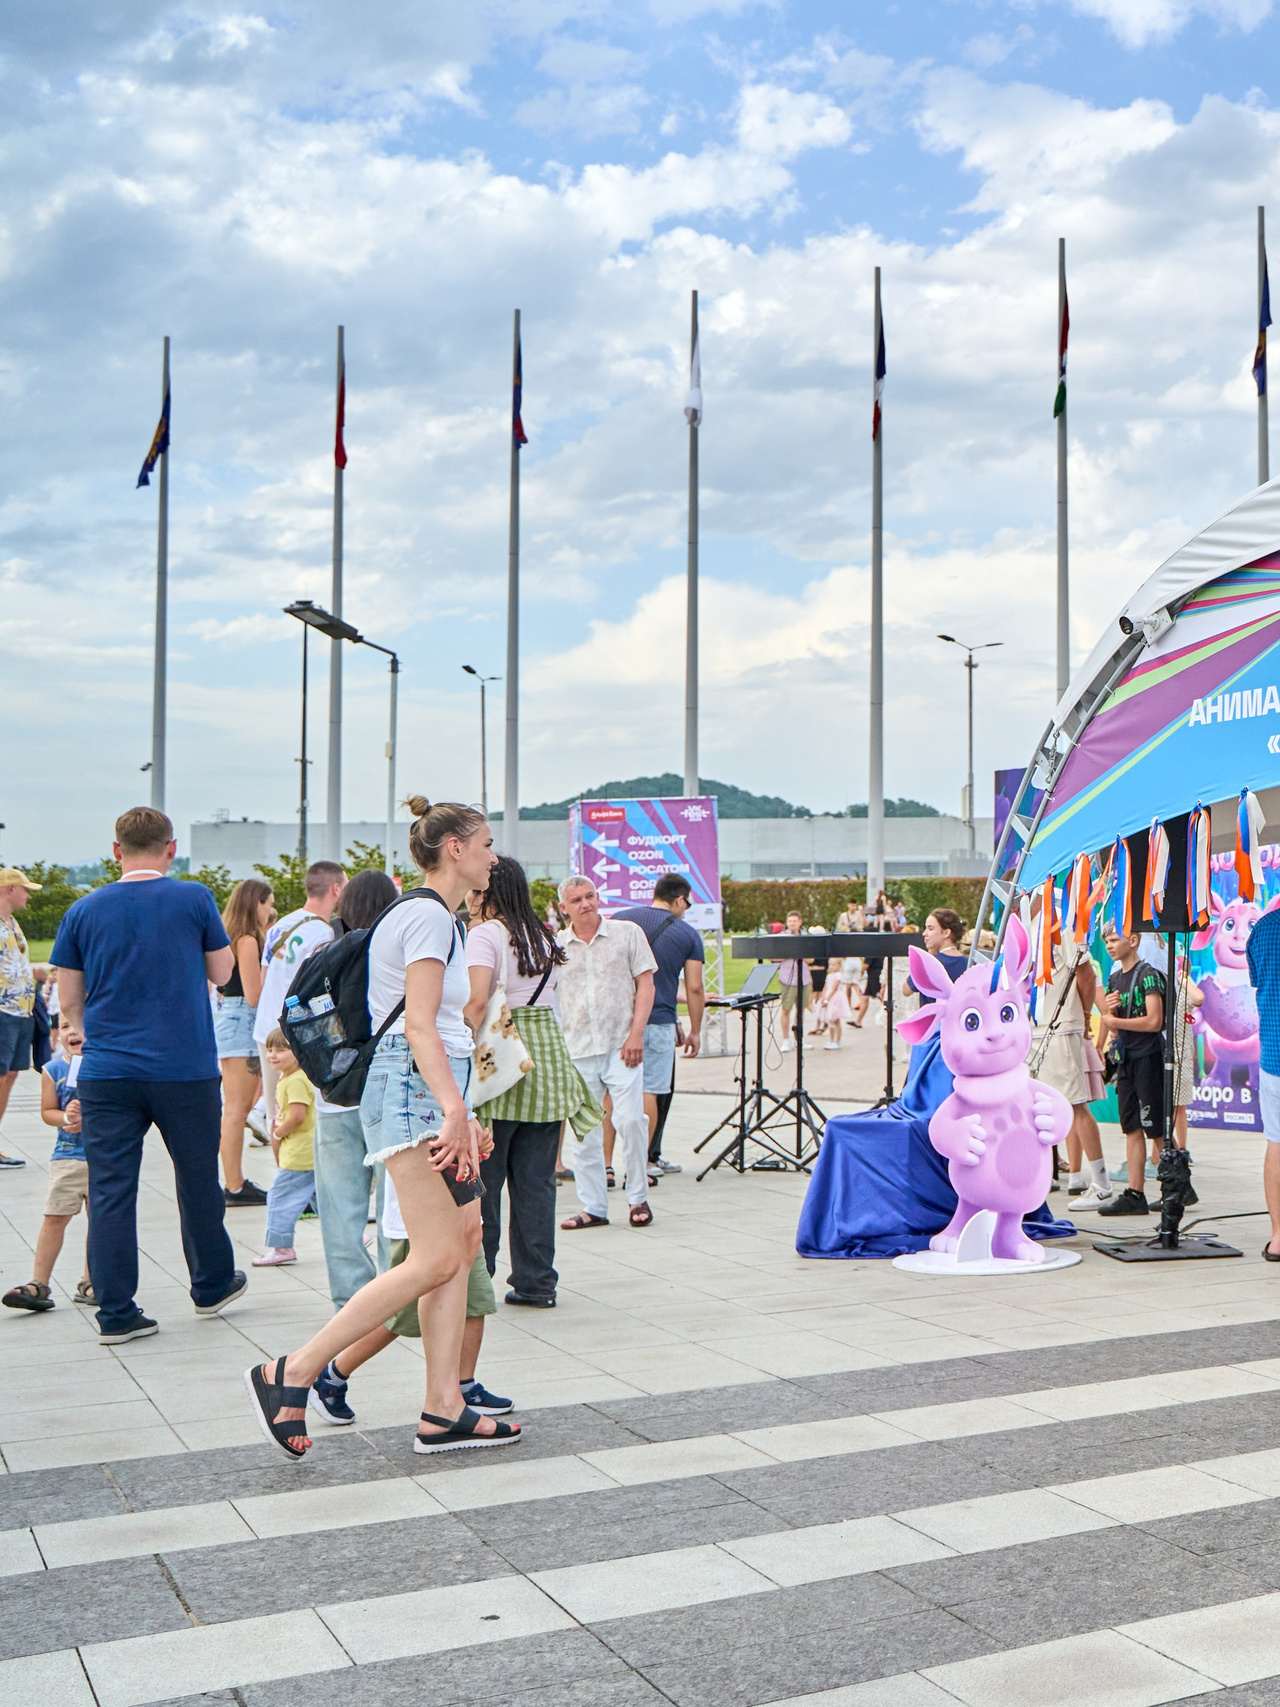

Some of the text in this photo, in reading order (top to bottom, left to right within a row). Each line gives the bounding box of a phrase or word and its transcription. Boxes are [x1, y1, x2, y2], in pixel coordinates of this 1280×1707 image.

[627, 835, 687, 846] ФУДКОРТ
[628, 850, 664, 860] OZON
[629, 864, 690, 875] РОСАТОМ
[629, 880, 656, 890] GOR
[630, 889, 654, 899] ENE
[1192, 1085, 1234, 1109] коро
